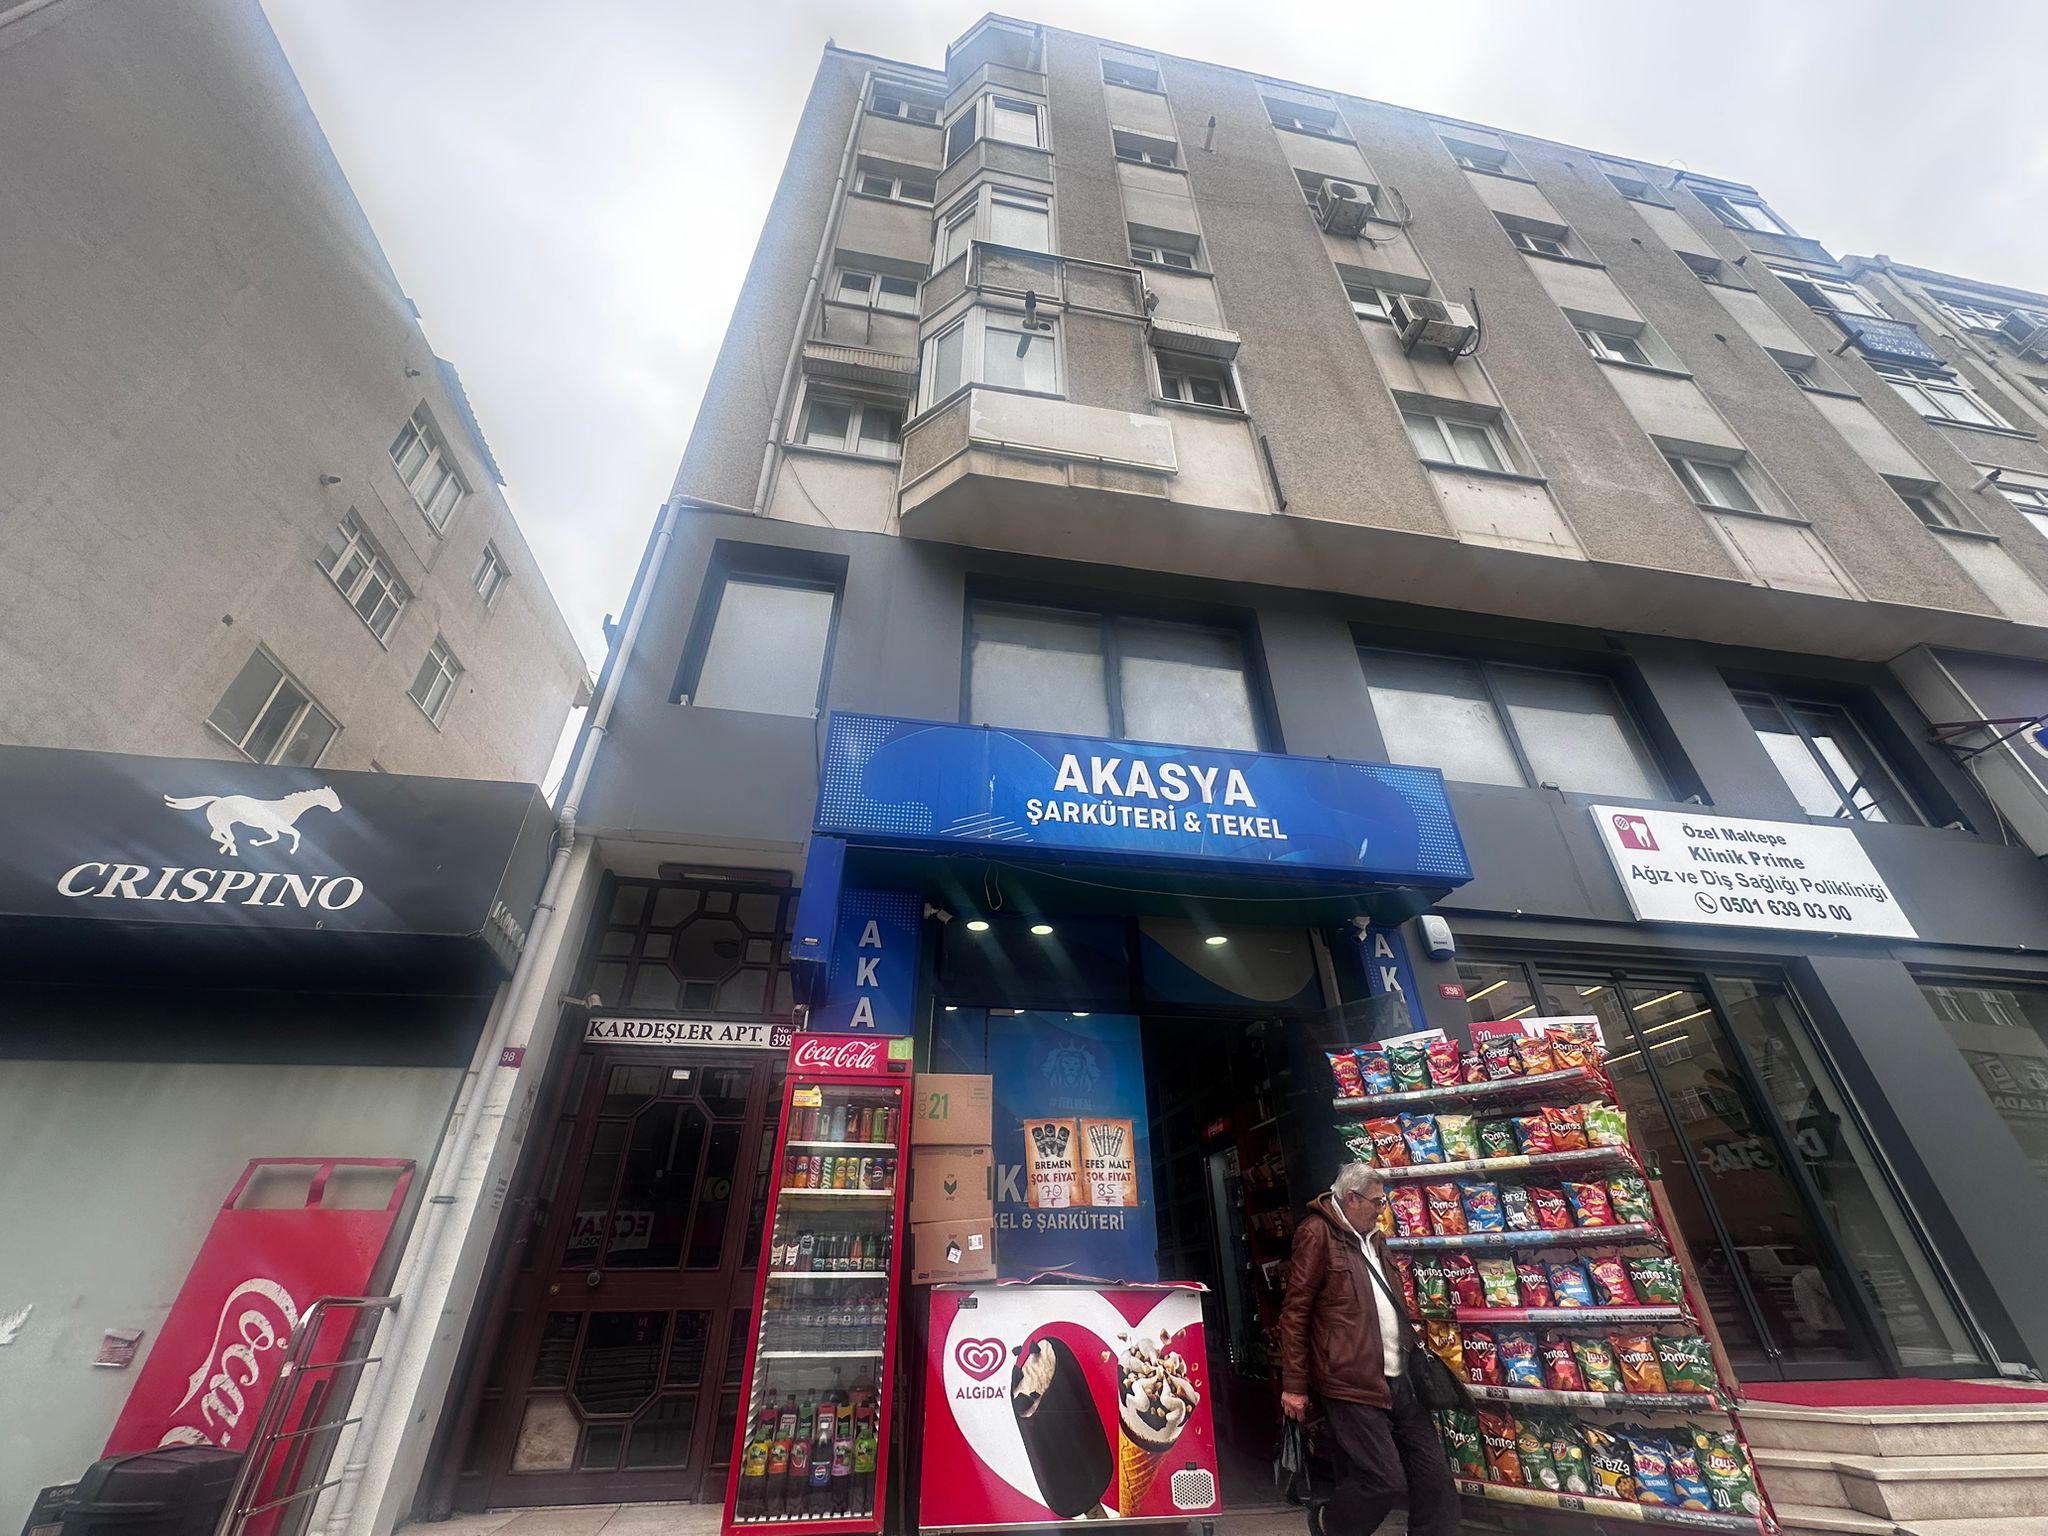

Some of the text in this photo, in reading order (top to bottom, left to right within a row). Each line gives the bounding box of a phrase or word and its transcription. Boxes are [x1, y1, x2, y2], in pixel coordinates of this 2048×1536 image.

[1054, 753, 1257, 808] AKASYA
[1026, 799, 1288, 840] ŞARKÜTERİ & TEKEL
[1682, 822, 1787, 847] Özel Maltepe
[1688, 846, 1806, 870] Klinik Prime
[57, 862, 364, 910] CRISPINO
[1632, 864, 1889, 904] Ağız ve Diş Sağlığı Polikliniği
[1719, 896, 1852, 921] 0501 639 03 00
[587, 1021, 763, 1043] KARDEŞLER APT.
[794, 1039, 881, 1068] Coca-Cola
[929, 1092, 949, 1120] 21
[1035, 1160, 1072, 1170] BREMEN
[1085, 1160, 1131, 1169] EFES MALT
[1031, 1169, 1077, 1185] ŞOK FİYAT
[1086, 1169, 1131, 1185] ŞOK FİYAT
[1042, 1184, 1062, 1197] 70
[1097, 1183, 1116, 1197] 85
[1022, 1213, 1032, 1229] &
[1037, 1210, 1125, 1233] ŞARKÜTERİ
[1443, 1265, 1475, 1278] Doritos
[1631, 1270, 1666, 1280] Doritos
[1471, 1368, 1482, 1381] 20
[1591, 1454, 1630, 1476] cerezza
